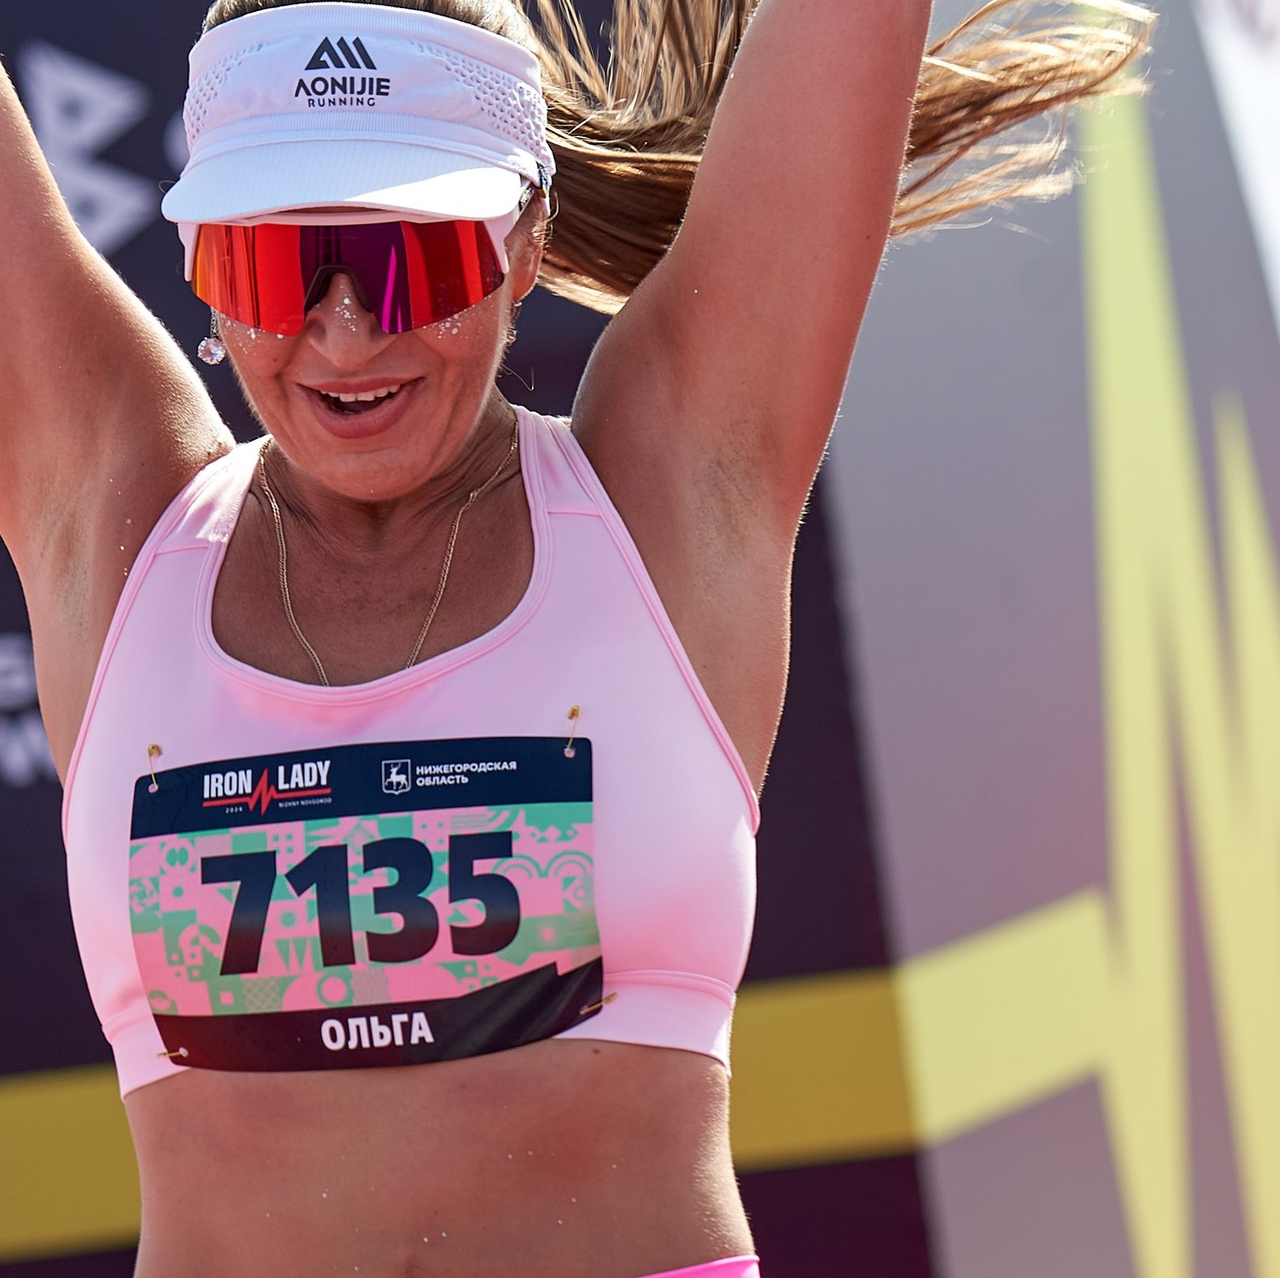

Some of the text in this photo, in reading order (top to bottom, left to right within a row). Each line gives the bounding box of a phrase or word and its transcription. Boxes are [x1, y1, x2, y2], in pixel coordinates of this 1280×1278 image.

[294, 76, 390, 98] AONIJIE
[308, 97, 375, 108] RUNNING
[203, 760, 331, 799] IRON LADY
[416, 761, 517, 776] НИЖЕГОРОДСКАЯ
[416, 775, 469, 787] ОБЛАСТЬ
[201, 831, 521, 976] 7135
[320, 1011, 435, 1051] ОЛЬГА
